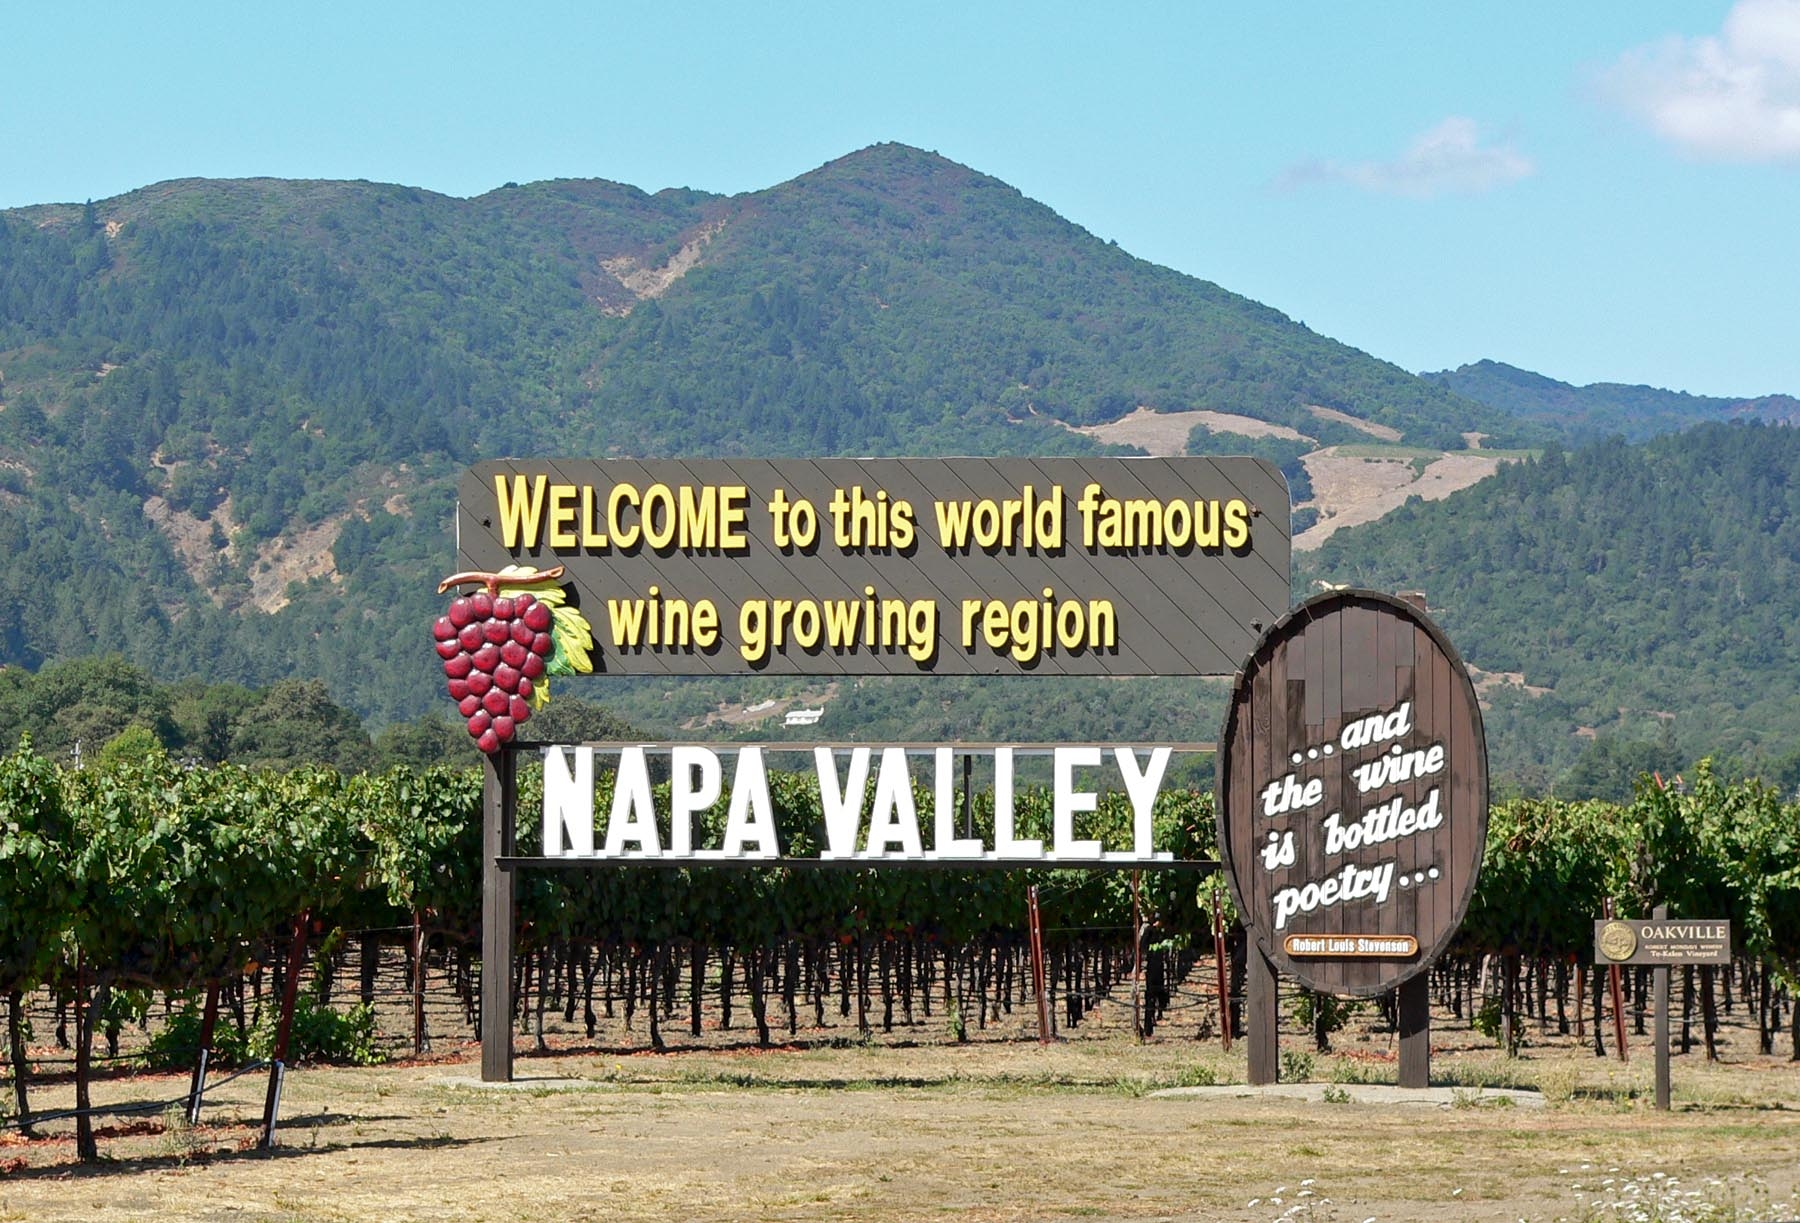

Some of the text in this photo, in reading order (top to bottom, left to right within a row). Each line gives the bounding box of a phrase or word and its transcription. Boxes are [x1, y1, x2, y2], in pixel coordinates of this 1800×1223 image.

[495, 474, 1250, 549] WELCOME to this world famous
[607, 585, 1115, 663] wine growing region
[543, 744, 1174, 862] NAPA VALLEY
[1261, 743, 1445, 817] the wine
[1261, 788, 1444, 871] is bottled
[1292, 938, 1409, 953] Robert Louis Stevenson
[1641, 925, 1726, 939] OAKVILLE
[1686, 950, 1718, 958] Vineyard
